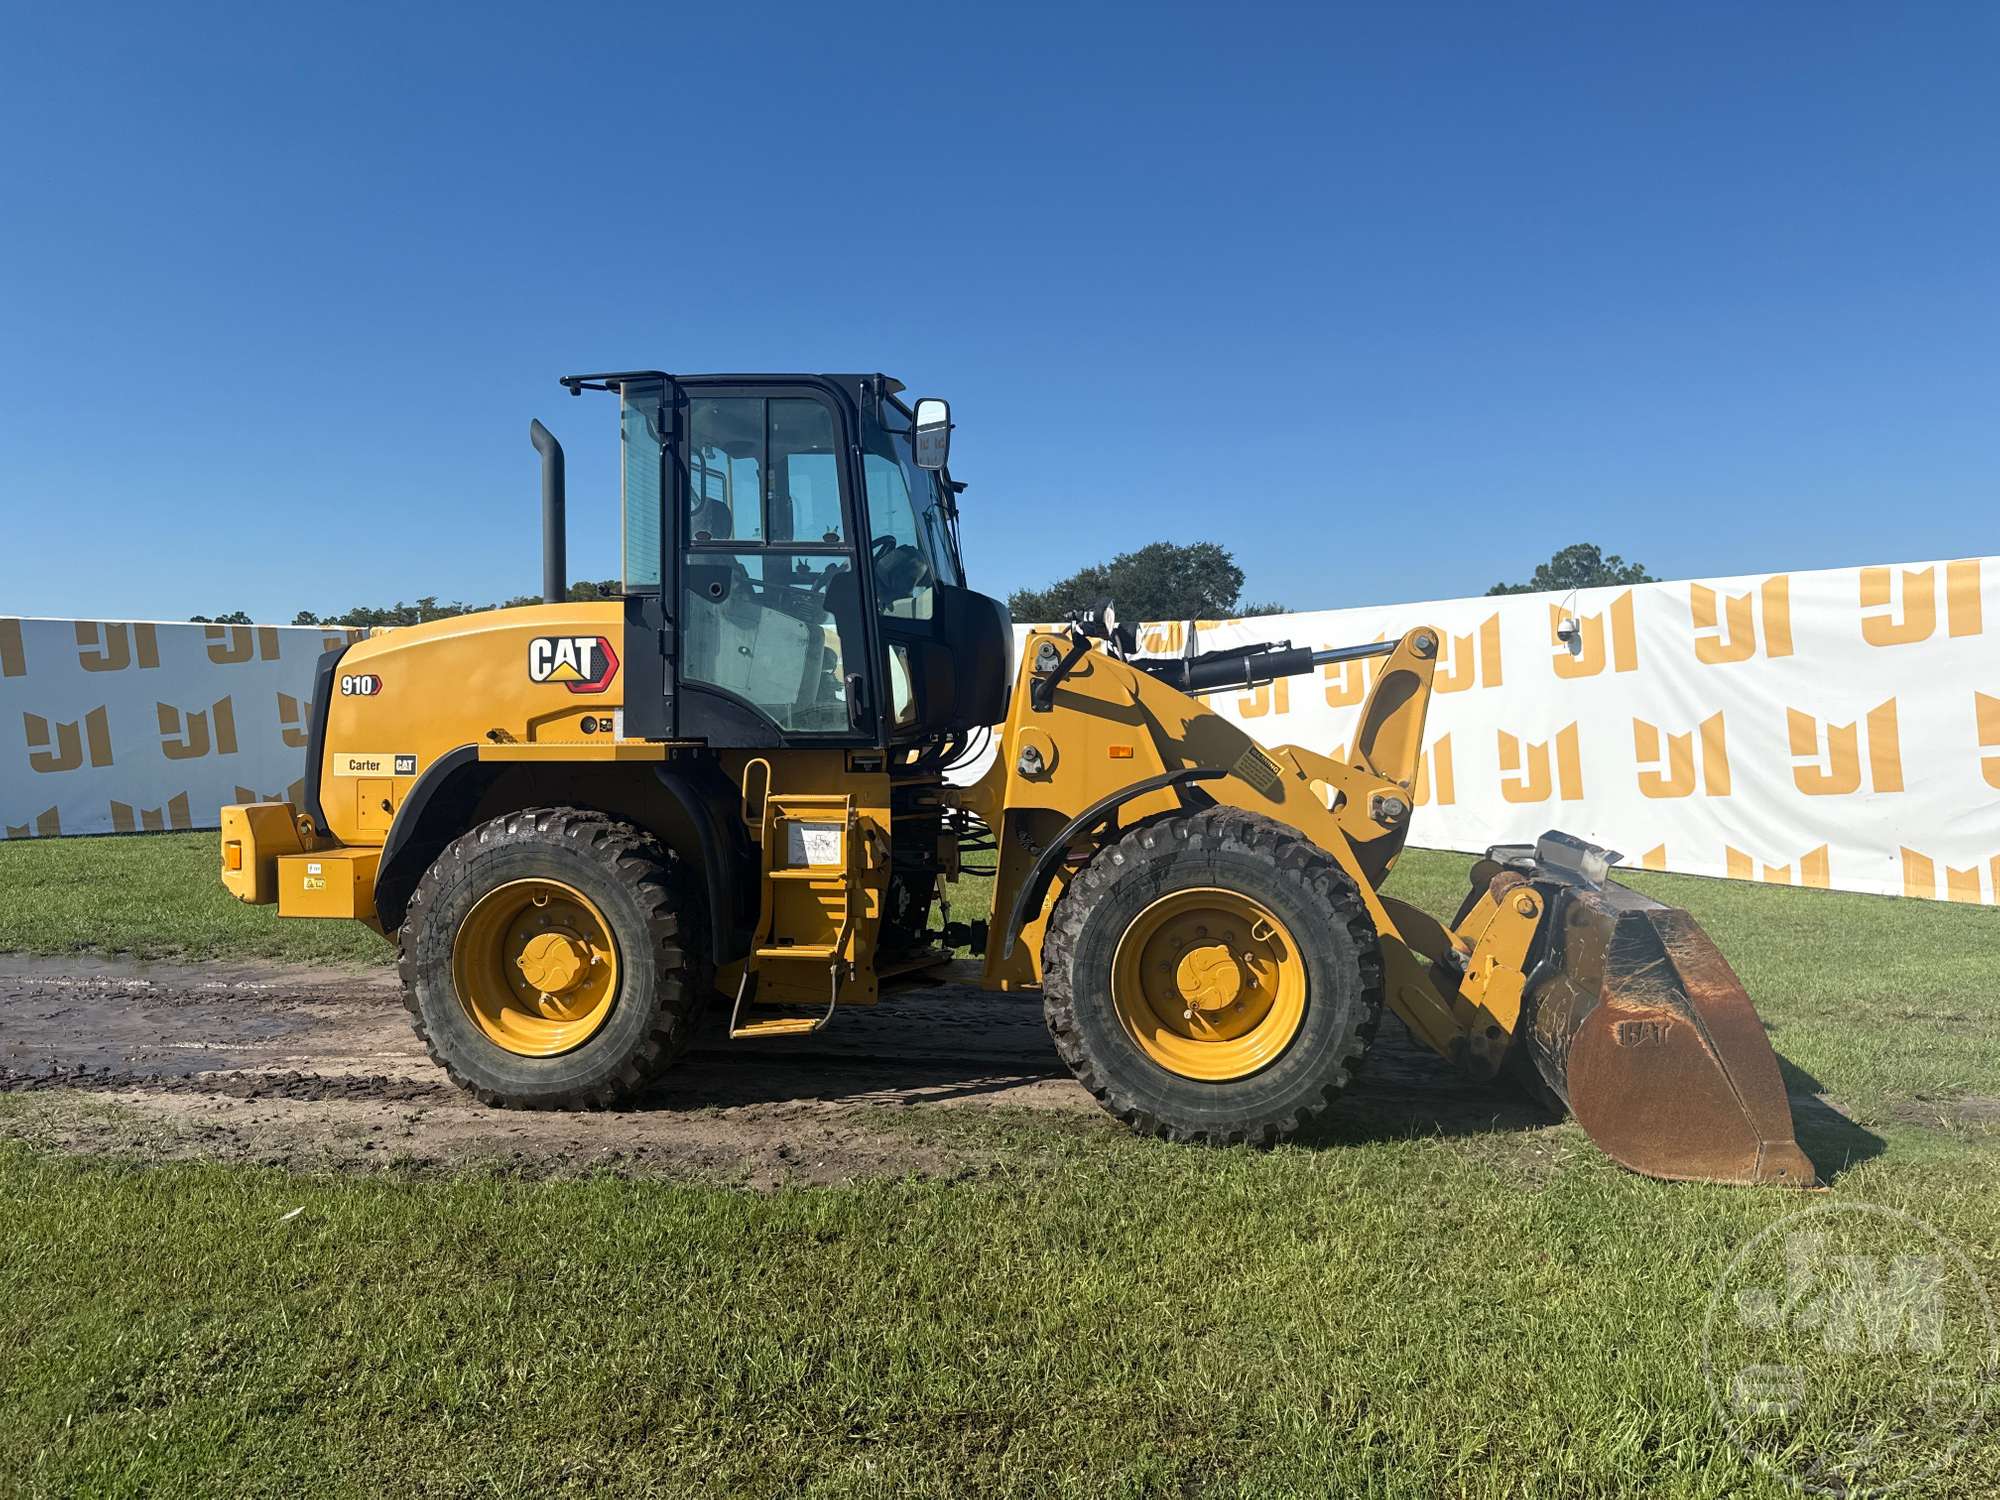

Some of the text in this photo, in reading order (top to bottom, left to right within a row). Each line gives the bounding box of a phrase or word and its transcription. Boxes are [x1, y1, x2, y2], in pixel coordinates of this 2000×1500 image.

[530, 638, 597, 682] CAT
[342, 675, 372, 695] 910
[349, 759, 414, 772] Carter CAT
